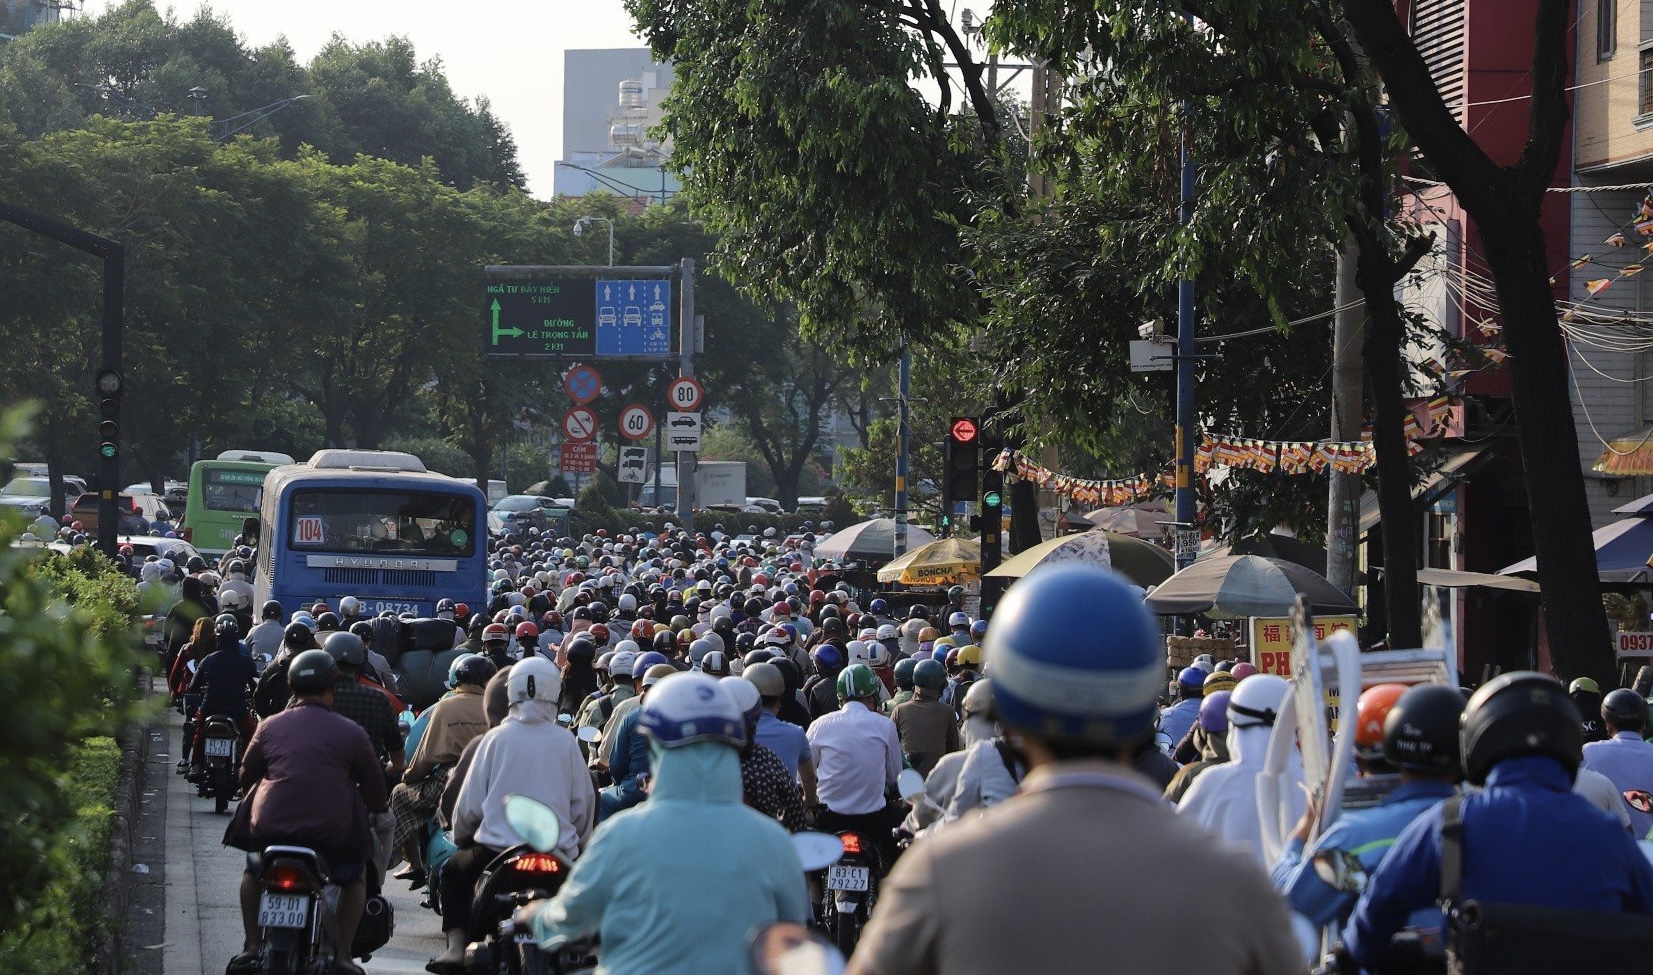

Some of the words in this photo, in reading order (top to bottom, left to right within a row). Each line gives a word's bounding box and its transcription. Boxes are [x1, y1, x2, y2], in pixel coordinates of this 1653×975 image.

[487, 283, 505, 294] NGÃ
[531, 296, 537, 304] 5
[541, 331, 569, 341] TRỌNG
[544, 343, 551, 351] 2
[551, 343, 564, 351] KM
[678, 387, 694, 402] 80
[628, 415, 644, 430] 60
[299, 519, 322, 542] 104
[335, 558, 431, 570] HYUNDAI
[917, 566, 954, 578] BONCHA
